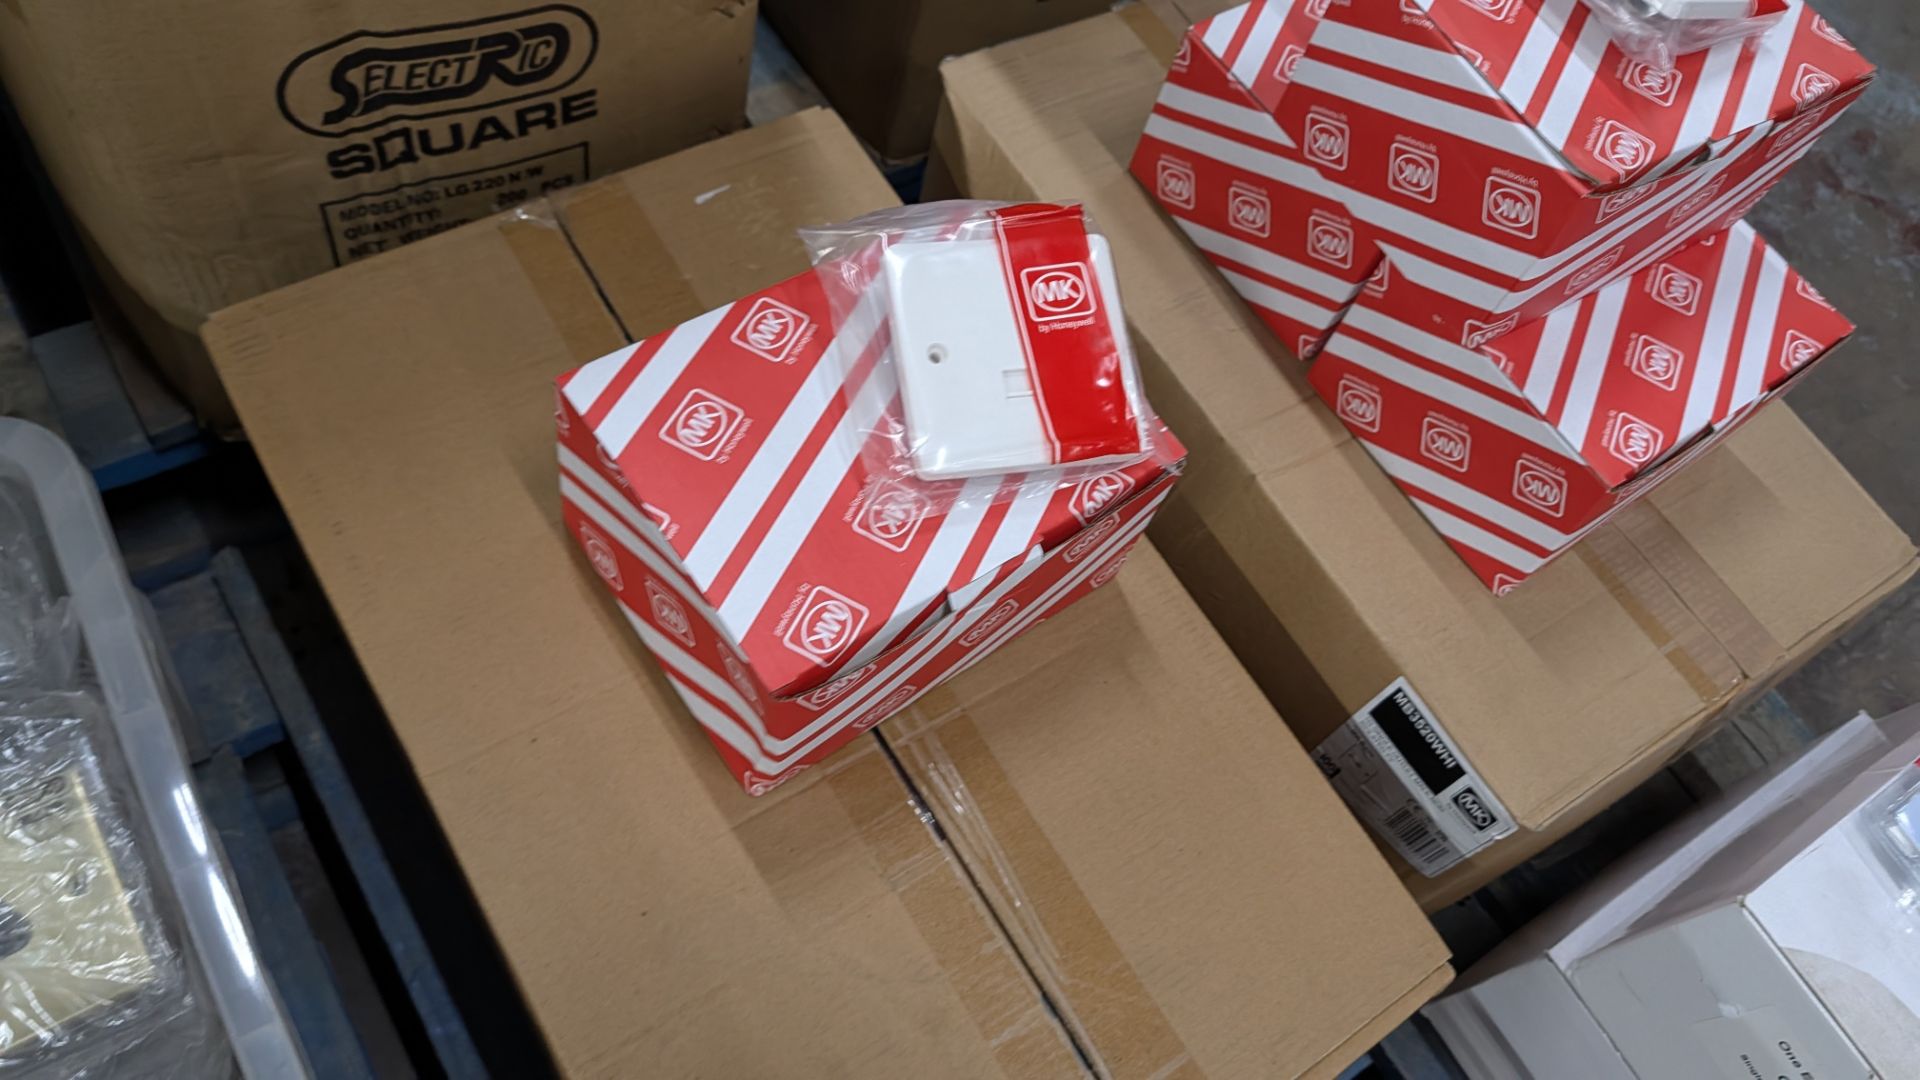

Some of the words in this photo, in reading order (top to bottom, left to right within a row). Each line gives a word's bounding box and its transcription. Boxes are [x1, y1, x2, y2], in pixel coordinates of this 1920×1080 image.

[321, 22, 571, 126] SELECTRIC
[326, 89, 597, 179] SQUARE
[1612, 134, 1641, 165] MK
[444, 183, 470, 198] LG
[473, 175, 505, 192] 220
[1400, 160, 1431, 187] MK
[1495, 193, 1530, 222] MK
[1034, 277, 1082, 305] MK
[750, 311, 791, 348] MK
[679, 405, 722, 443] MK
[1432, 431, 1464, 459] MK
[1625, 426, 1650, 458] MK
[1085, 476, 1122, 516] MK
[1525, 475, 1558, 503] MK
[806, 603, 849, 650] MK
[1459, 794, 1490, 825] MK
[1778, 1040, 1803, 1068] One
